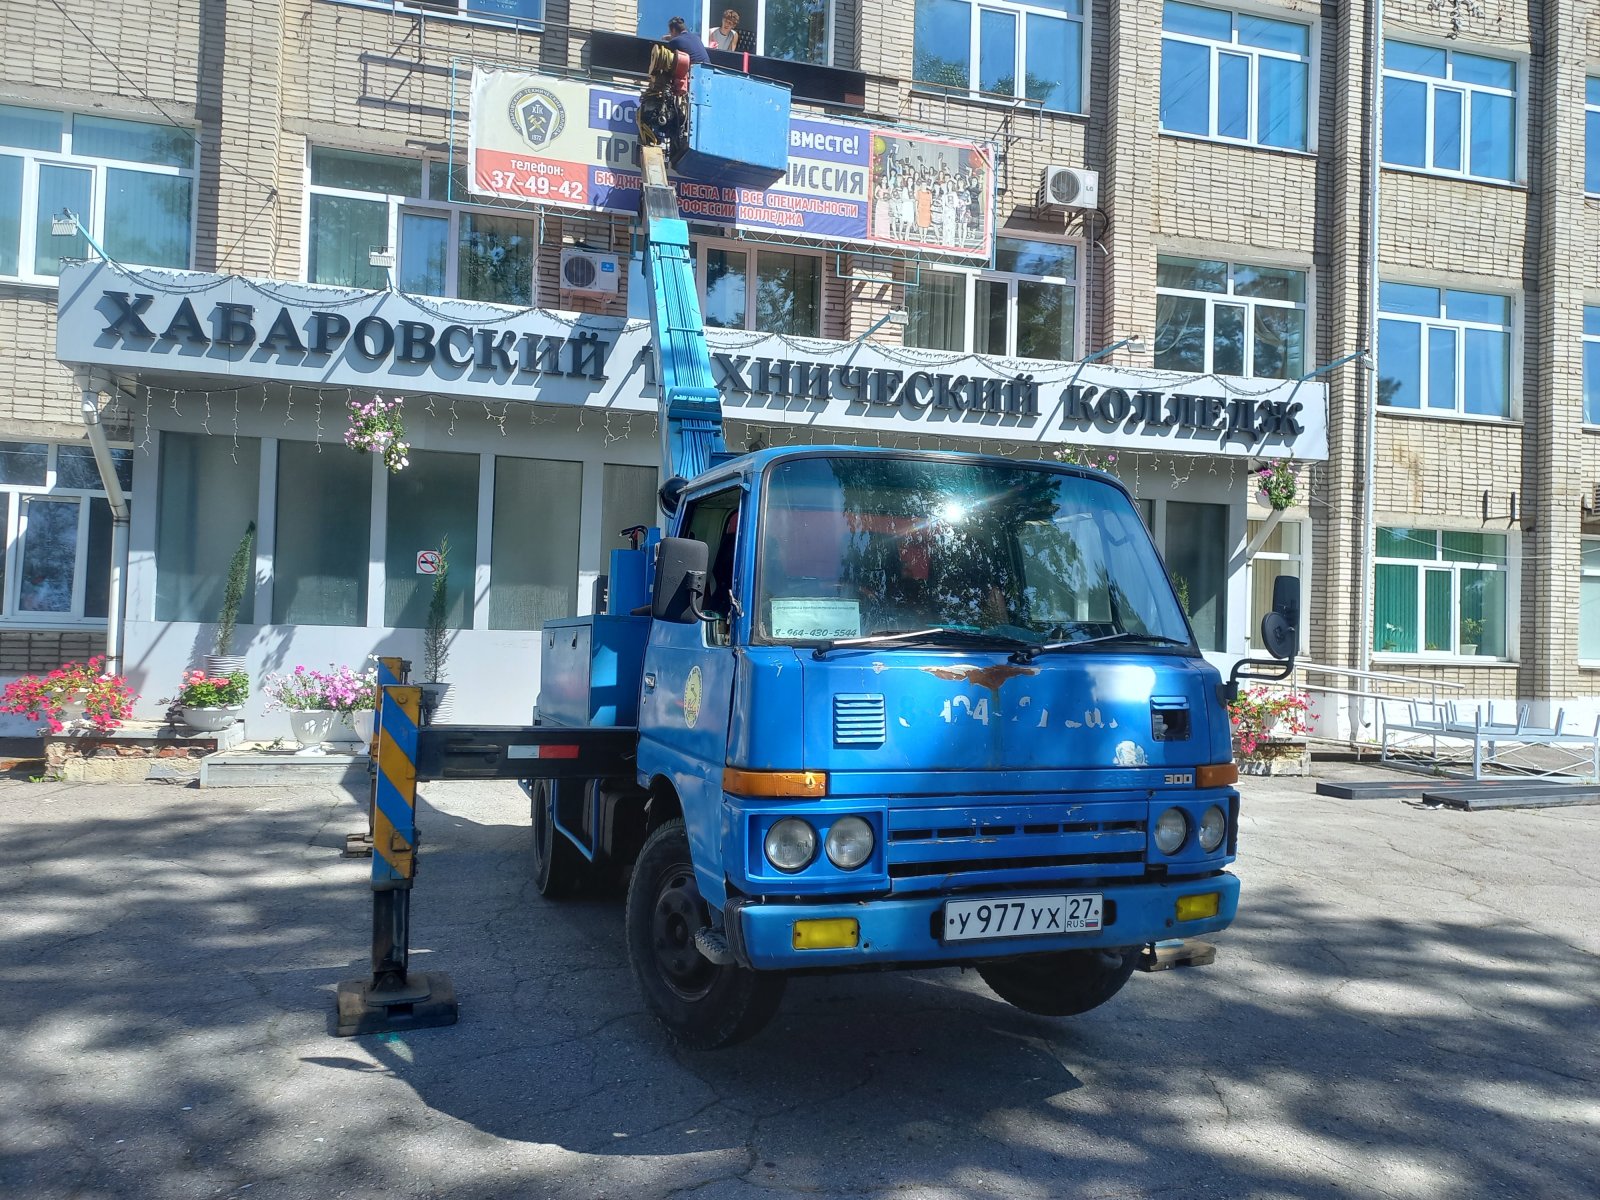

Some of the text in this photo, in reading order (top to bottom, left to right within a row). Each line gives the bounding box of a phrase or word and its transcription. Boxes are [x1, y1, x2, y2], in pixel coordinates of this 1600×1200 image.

[531, 104, 544, 115] ХТК
[790, 129, 859, 155] вместе!
[511, 159, 564, 176] телефон:
[491, 170, 583, 200] 37-49-42
[681, 182, 719, 200] МЕСТА
[723, 188, 739, 203] НА
[741, 191, 763, 207] ВСЕ
[767, 194, 858, 218] СПЕЦИАЛЬНОСТИ
[739, 206, 804, 227] КОЛЛЕДЖА
[101, 290, 1305, 443] ХАБАРОВСКИЙ ХНИЧЕСКИЙ КОЛЛЕДЖ
[1164, 773, 1193, 785] 300
[1069, 898, 1093, 920] 27
[1066, 919, 1085, 928] RUS
